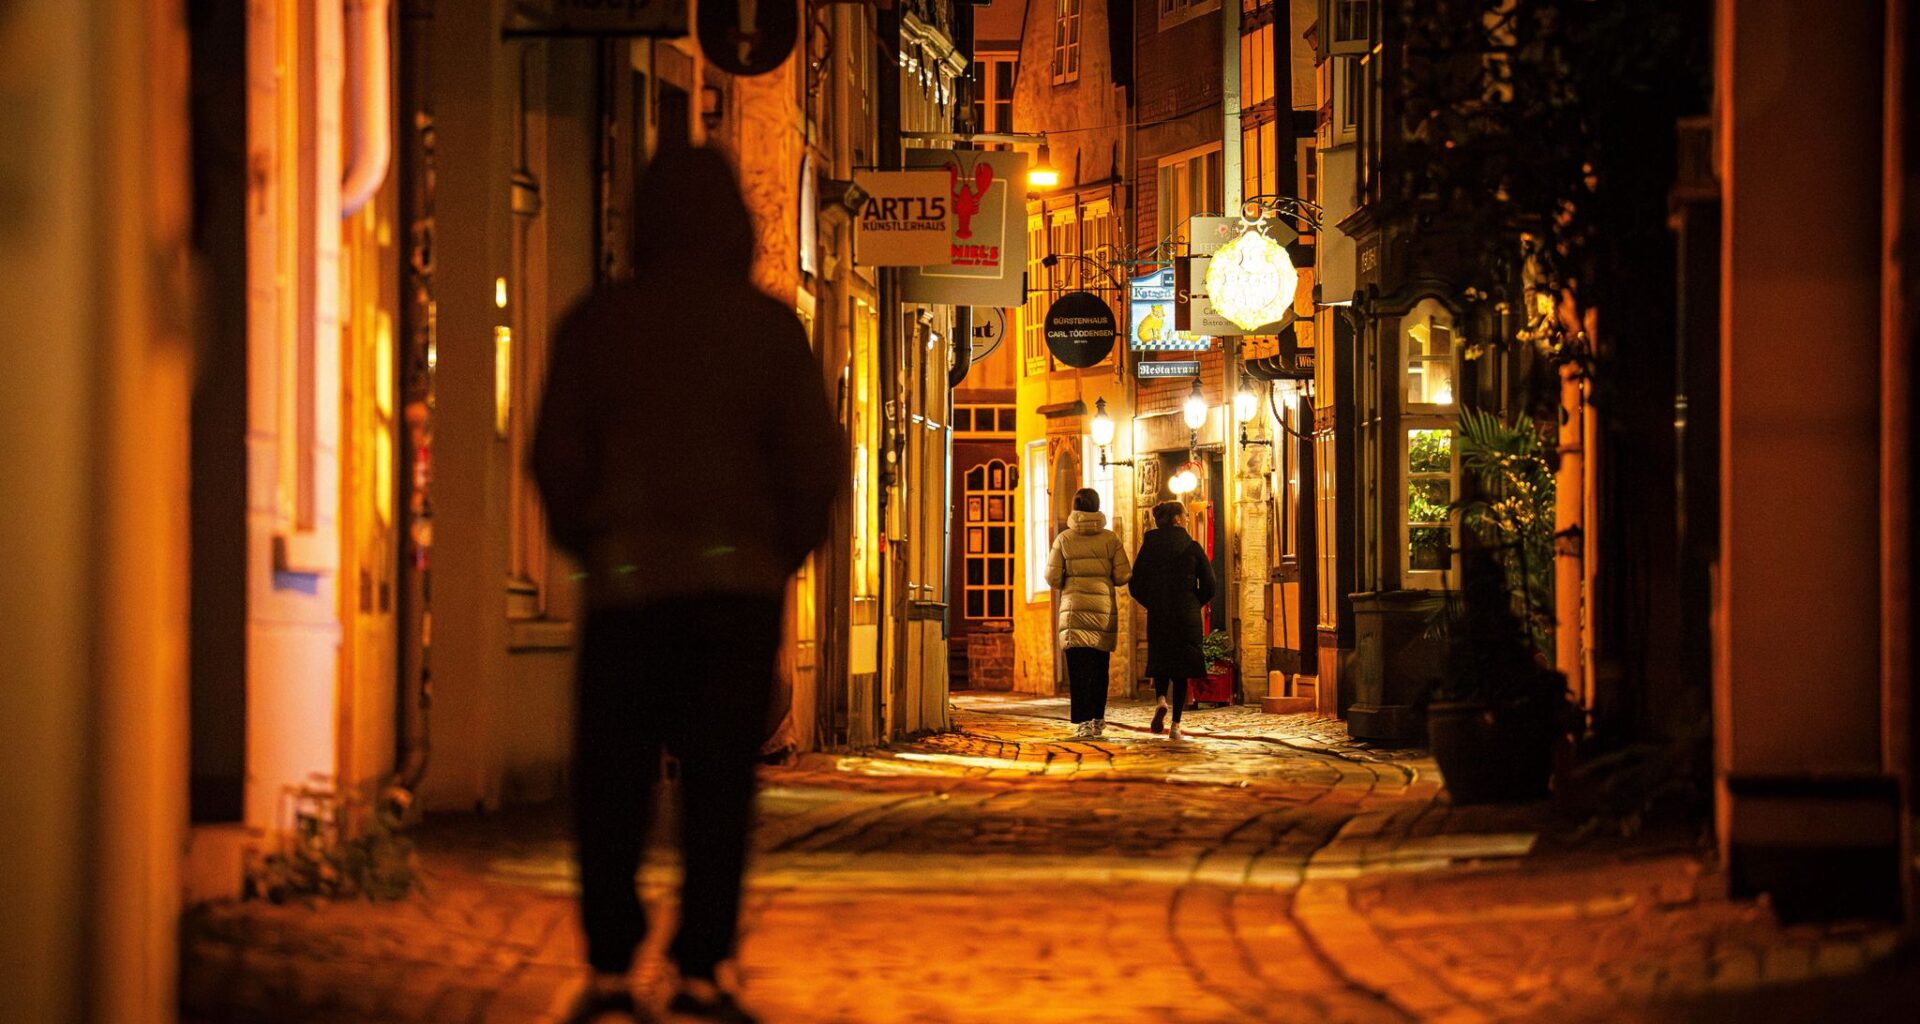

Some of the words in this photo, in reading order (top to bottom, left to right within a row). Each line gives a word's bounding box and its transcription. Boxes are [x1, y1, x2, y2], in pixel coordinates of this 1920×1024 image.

[864, 197, 946, 221] ART15
[863, 221, 946, 232] KÜNSTLERHAUS
[1053, 316, 1109, 325] BÜRSTENHAUS
[1047, 330, 1068, 339] CARL
[1068, 328, 1114, 338] TÖDDENSEN
[1139, 364, 1199, 375] Restaurant
